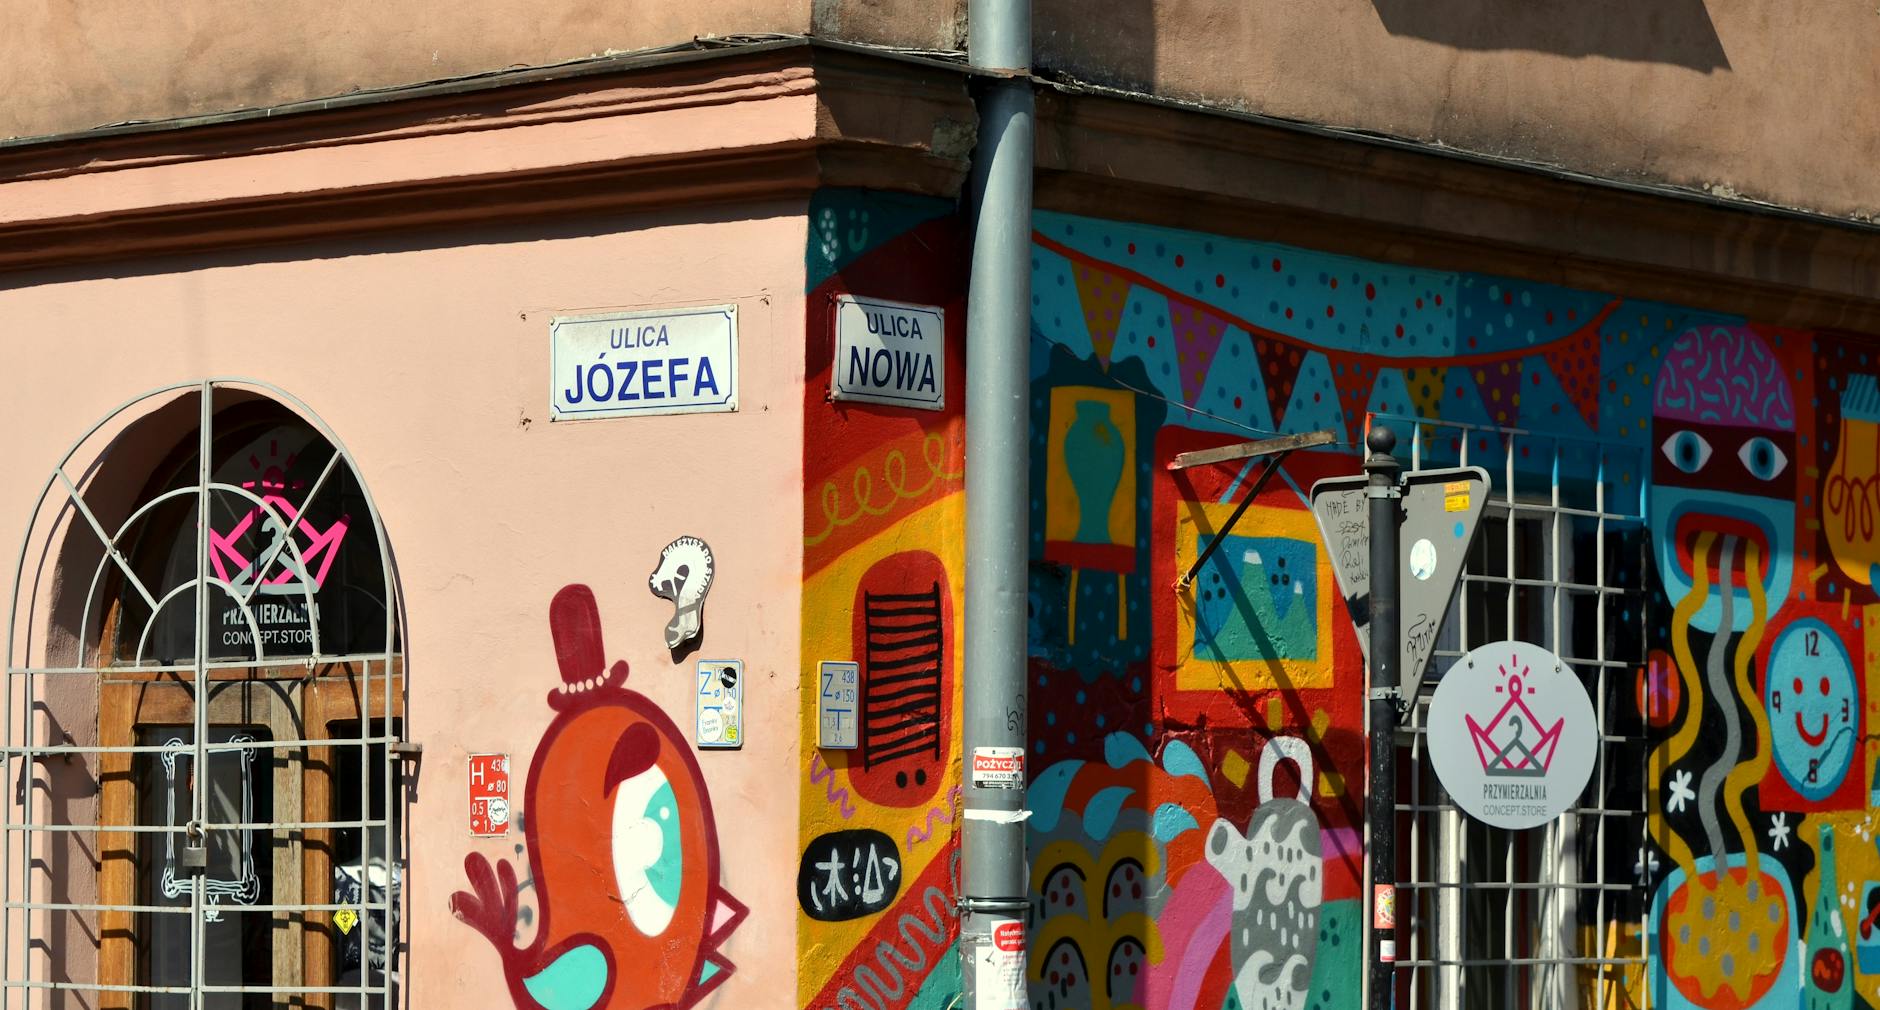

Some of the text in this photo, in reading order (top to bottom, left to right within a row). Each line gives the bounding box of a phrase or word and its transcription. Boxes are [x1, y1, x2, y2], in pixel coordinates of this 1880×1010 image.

[609, 324, 670, 350] ULICA
[867, 311, 923, 341] ULICA
[564, 352, 719, 404] JÓZEFA
[848, 345, 936, 393] NOWA
[1804, 630, 1820, 657] 12
[699, 671, 712, 695] Z
[823, 673, 834, 697] Z
[841, 670, 855, 684] 438
[842, 688, 855, 703] 150
[471, 762, 485, 786] H
[496, 779, 507, 793] 80
[1483, 783, 1547, 801] PRZYMIERZALNIA
[1482, 804, 1547, 817] CONCEPT.STORE
